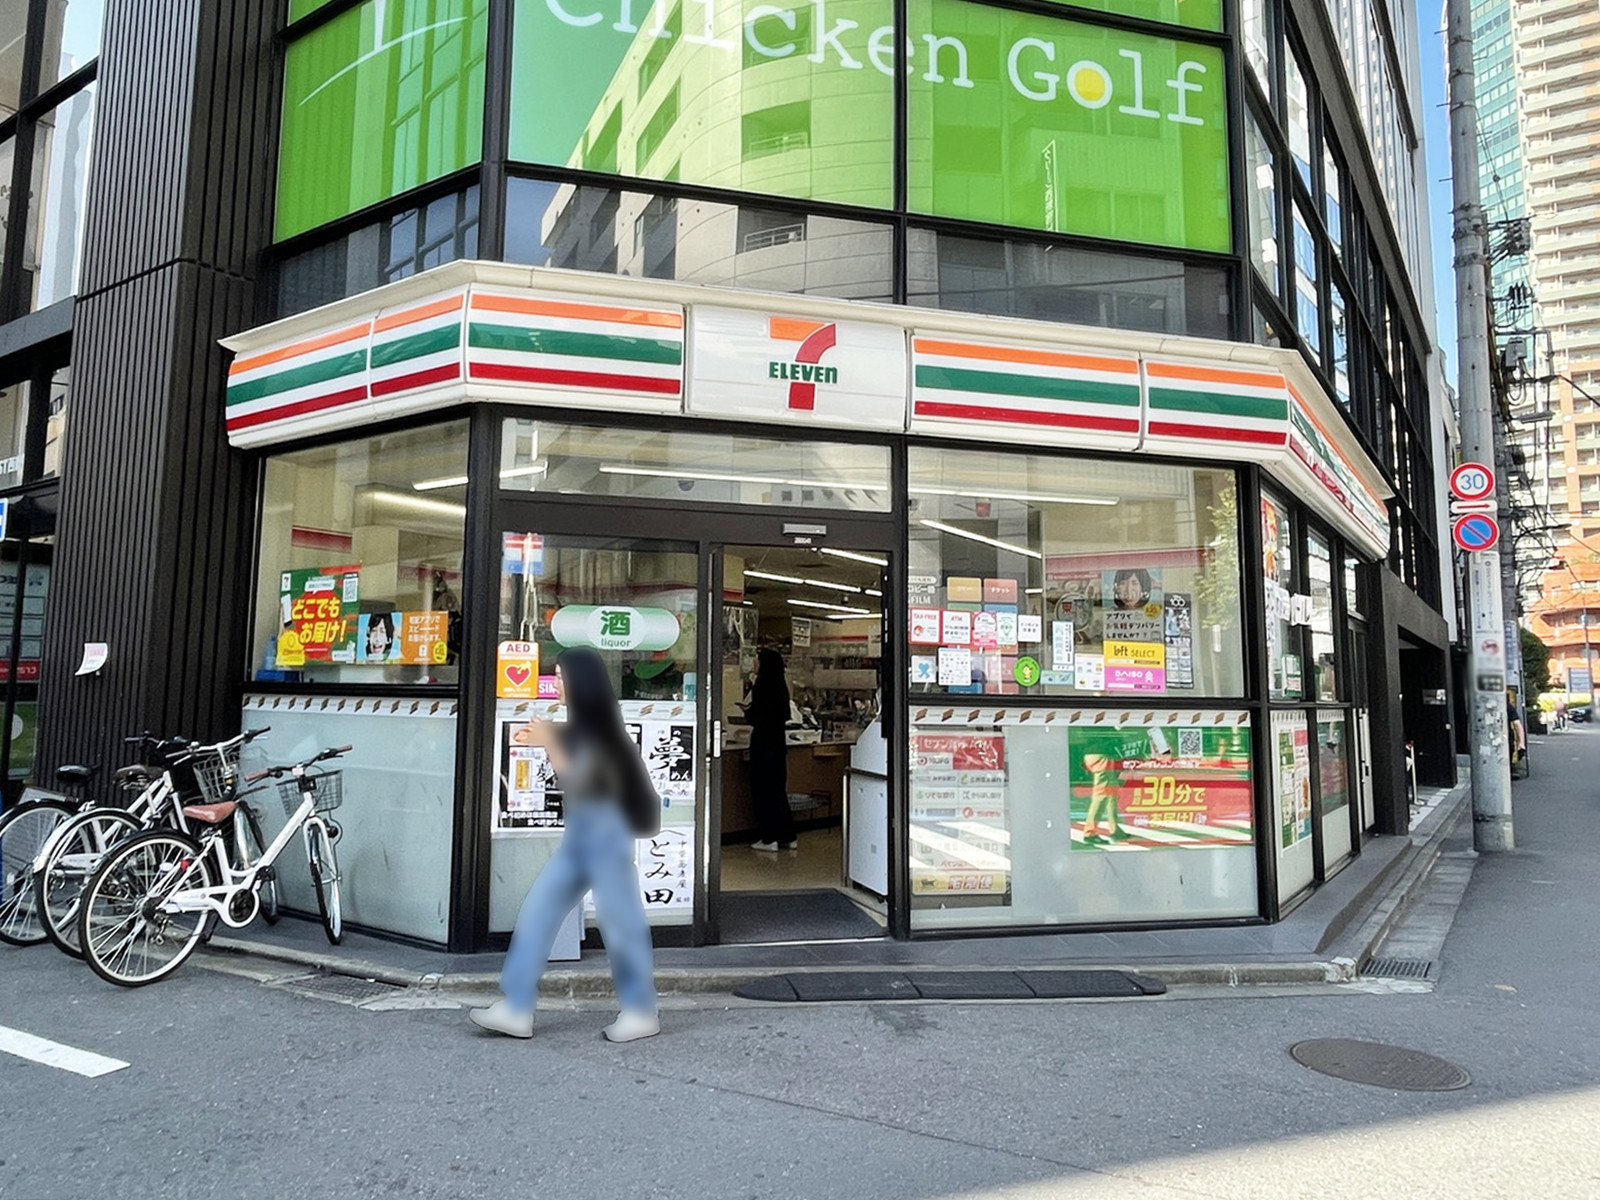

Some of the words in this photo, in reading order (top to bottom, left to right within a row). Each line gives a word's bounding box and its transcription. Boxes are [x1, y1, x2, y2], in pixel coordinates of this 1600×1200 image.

[1007, 37, 1207, 126] Golf
[769, 317, 836, 410] 7
[1460, 473, 1485, 491] 30
[292, 597, 341, 620] どこでも
[600, 609, 632, 636] 酒
[506, 643, 531, 653] AED
[600, 638, 632, 647] liquor
[1131, 649, 1155, 658] SELECT
[1115, 670, 1143, 678] DAISO
[649, 736, 691, 770] 夢
[644, 839, 674, 904] とみ田
